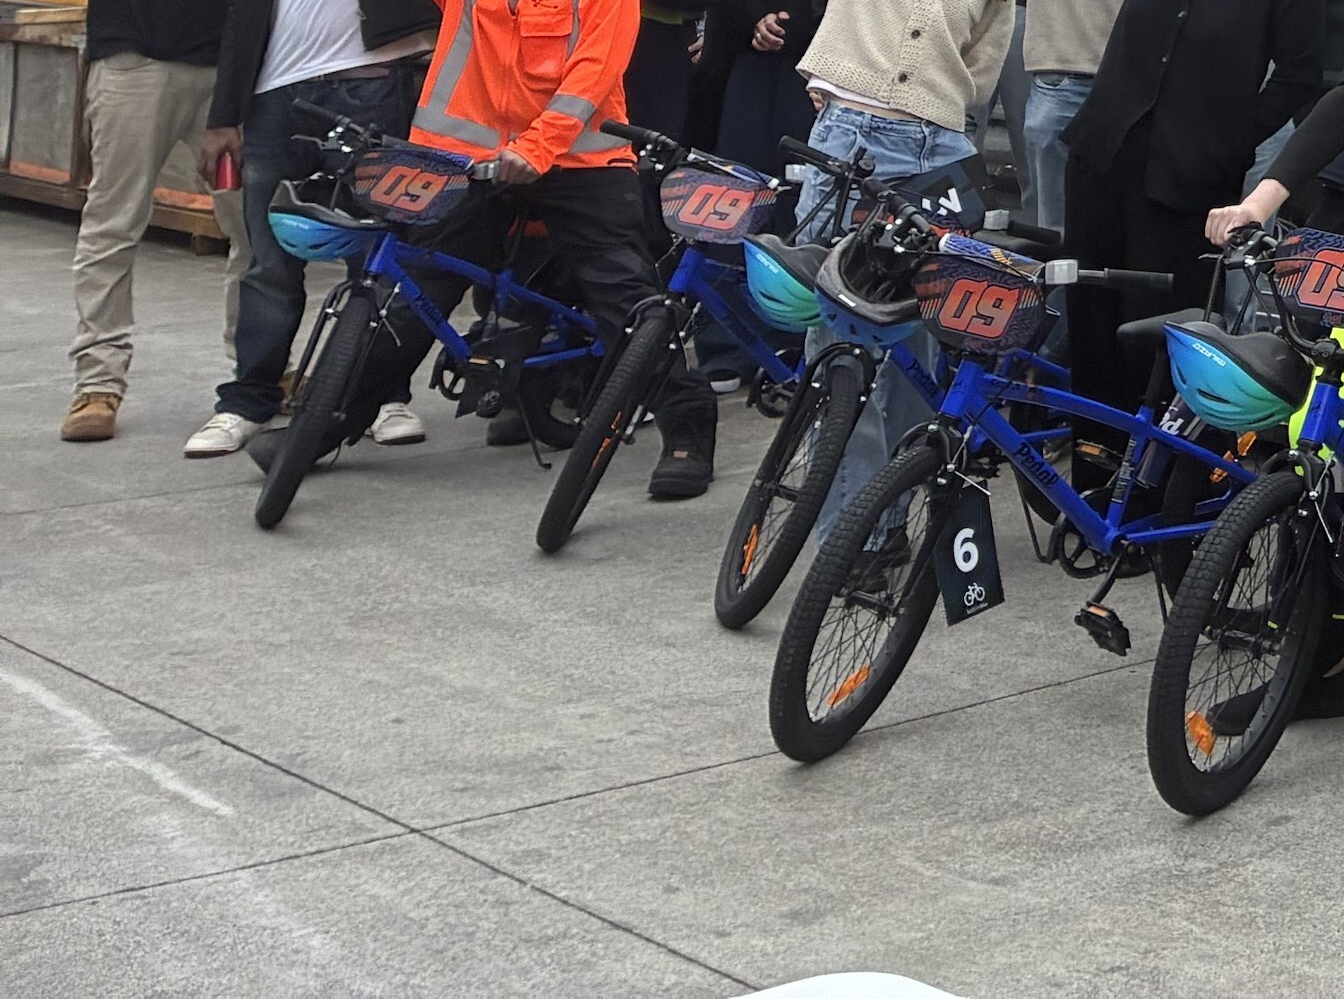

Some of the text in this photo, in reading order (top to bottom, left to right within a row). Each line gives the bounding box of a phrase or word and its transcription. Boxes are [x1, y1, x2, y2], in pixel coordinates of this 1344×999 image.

[369, 166, 449, 212] 09
[678, 184, 755, 231] 09
[938, 278, 1021, 339] 09
[1192, 342, 1227, 367] MILAZO
[953, 527, 979, 573] 6
